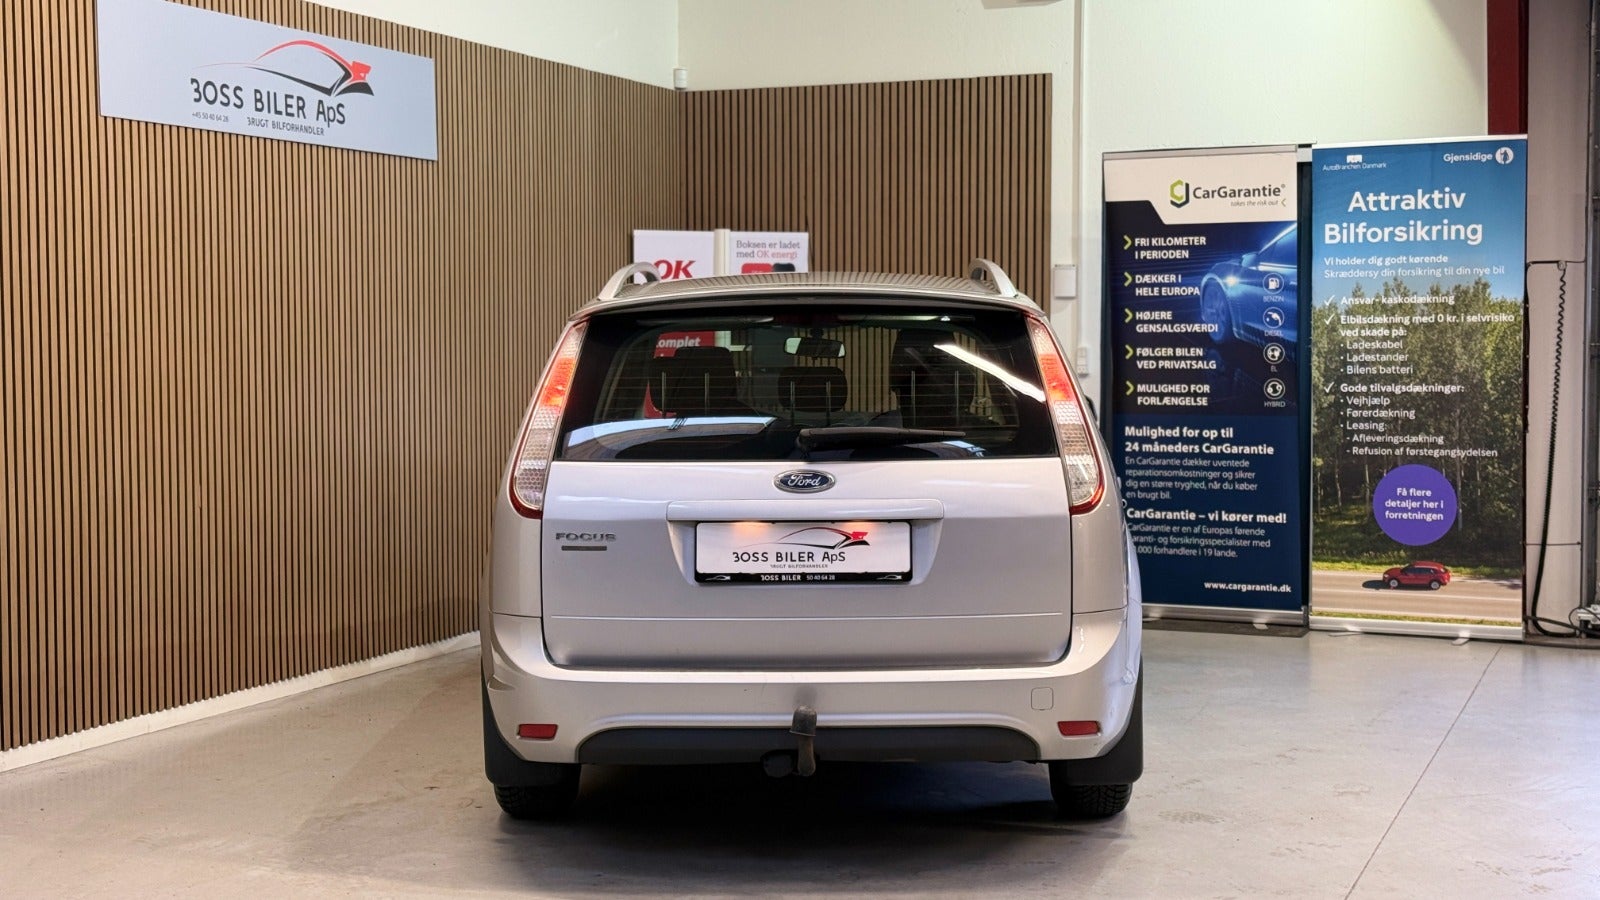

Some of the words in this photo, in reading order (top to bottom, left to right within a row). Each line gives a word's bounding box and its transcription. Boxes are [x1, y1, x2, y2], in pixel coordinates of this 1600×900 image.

[254, 89, 306, 119] BILER
[316, 100, 346, 128] ApS
[272, 119, 324, 136] BILFORHANDLER
[1443, 152, 1493, 163] Gjensidige
[1348, 187, 1466, 212] Attraktiv
[1324, 219, 1483, 245] Bilforsikring
[1134, 237, 1149, 246] FRI
[1151, 236, 1206, 246] KILOMETER
[771, 251, 797, 259] energi
[1135, 251, 1138, 260] I
[1140, 250, 1189, 260] PERIODEN
[1324, 258, 1334, 266] Vi
[1335, 257, 1366, 266] holder
[1368, 256, 1383, 266] dig
[1385, 256, 1407, 266] godt
[1409, 255, 1448, 264] kørende
[1324, 269, 1379, 279] Skræddersy
[1381, 268, 1396, 277] din
[1398, 267, 1441, 277] forsikring
[1443, 267, 1454, 276] til
[1456, 266, 1470, 275] din
[1473, 268, 1490, 277] nye
[1493, 266, 1505, 275] bil
[1135, 275, 1176, 284] DÆKKER
[1178, 274, 1182, 283] I
[1136, 287, 1160, 296] HELE
[1162, 287, 1200, 296] EUROPA
[1381, 295, 1455, 305] kaskodækning
[1136, 311, 1172, 320] HØJERE
[1341, 316, 1410, 325] Elbilsdækning
[1412, 315, 1435, 323] med
[1438, 314, 1444, 322] 0
[1446, 314, 1459, 323] kr.
[1466, 314, 1514, 323] selvrisiko
[1136, 324, 1218, 333] GENSALGSVÆRDI
[1341, 328, 1358, 336] ved
[1360, 328, 1390, 336] skade
[1391, 327, 1407, 338] på:
[1346, 341, 1403, 350] Ladeskabel
[1136, 348, 1174, 357] FØLGER
[1176, 348, 1203, 356] BILEN
[1346, 353, 1409, 362] Ladestander
[1137, 360, 1157, 369] VED
[1158, 360, 1217, 370] PRIVATSALG
[1346, 365, 1377, 374] Bilens
[1379, 365, 1413, 374] batteri
[1137, 384, 1188, 393] MULIGHED
[1190, 384, 1210, 393] FOR
[1340, 384, 1367, 393] Gode
[1370, 383, 1464, 394] tilvalgsdækninger:
[1137, 397, 1208, 406] FORLÆNGELSE
[1346, 396, 1390, 406] Vejhjælp
[1346, 409, 1415, 419] Førerdækning
[1346, 421, 1387, 431] Leasing:
[1125, 426, 1180, 439] Mulighed
[1182, 426, 1200, 438] for
[1202, 429, 1217, 440] op
[1221, 427, 1233, 438] til
[1352, 435, 1444, 445] Afleveringsdækning
[1125, 442, 1140, 452] 24
[1142, 441, 1200, 453] måneders
[1202, 443, 1274, 454] CarGarantie
[1352, 447, 1394, 455] Refusion
[1396, 447, 1404, 455] af
[1405, 448, 1498, 457] førstegangsydelsen
[1136, 457, 1180, 466] CarGarantie
[1182, 458, 1211, 466] dækker
[1212, 459, 1250, 467] uventede
[1126, 469, 1220, 480] reparationsomkostninger
[1222, 472, 1233, 480] og
[1235, 471, 1255, 479] sikrer
[787, 474, 822, 489] Ford
[1126, 480, 1137, 489] dig
[1151, 480, 1173, 488] større
[1174, 480, 1207, 490] tryghed,
[1208, 481, 1221, 489] når
[1235, 482, 1257, 490] køber
[1137, 491, 1158, 500] brugt
[1160, 491, 1172, 499] bil.
[1397, 487, 1407, 496] Få
[1409, 488, 1432, 497] flere
[1385, 499, 1421, 509] detaljer
[1423, 499, 1439, 508] her
[1127, 508, 1196, 520] CarGarantie
[1208, 511, 1219, 521] vi
[1222, 511, 1253, 522] kører
[1256, 513, 1287, 523] med!
[1385, 511, 1444, 522] forretningen
[1128, 523, 1170, 532] CarGarantie
[1193, 525, 1200, 533] af
[1202, 526, 1233, 536] Europas
[1235, 526, 1265, 536] førende
[555, 532, 616, 542] FOCUS
[1132, 534, 1156, 543] aranti-
[1158, 537, 1168, 545] og
[1170, 536, 1251, 547] forsikringsspecialister
[1252, 539, 1270, 548] med
[1154, 546, 1197, 556] forhandlere
[1203, 548, 1212, 556] 19
[1214, 549, 1238, 558] lande.
[776, 552, 814, 562] BILER
[822, 552, 846, 564] ApS
[1204, 581, 1291, 593] www.cargarantie.dk
